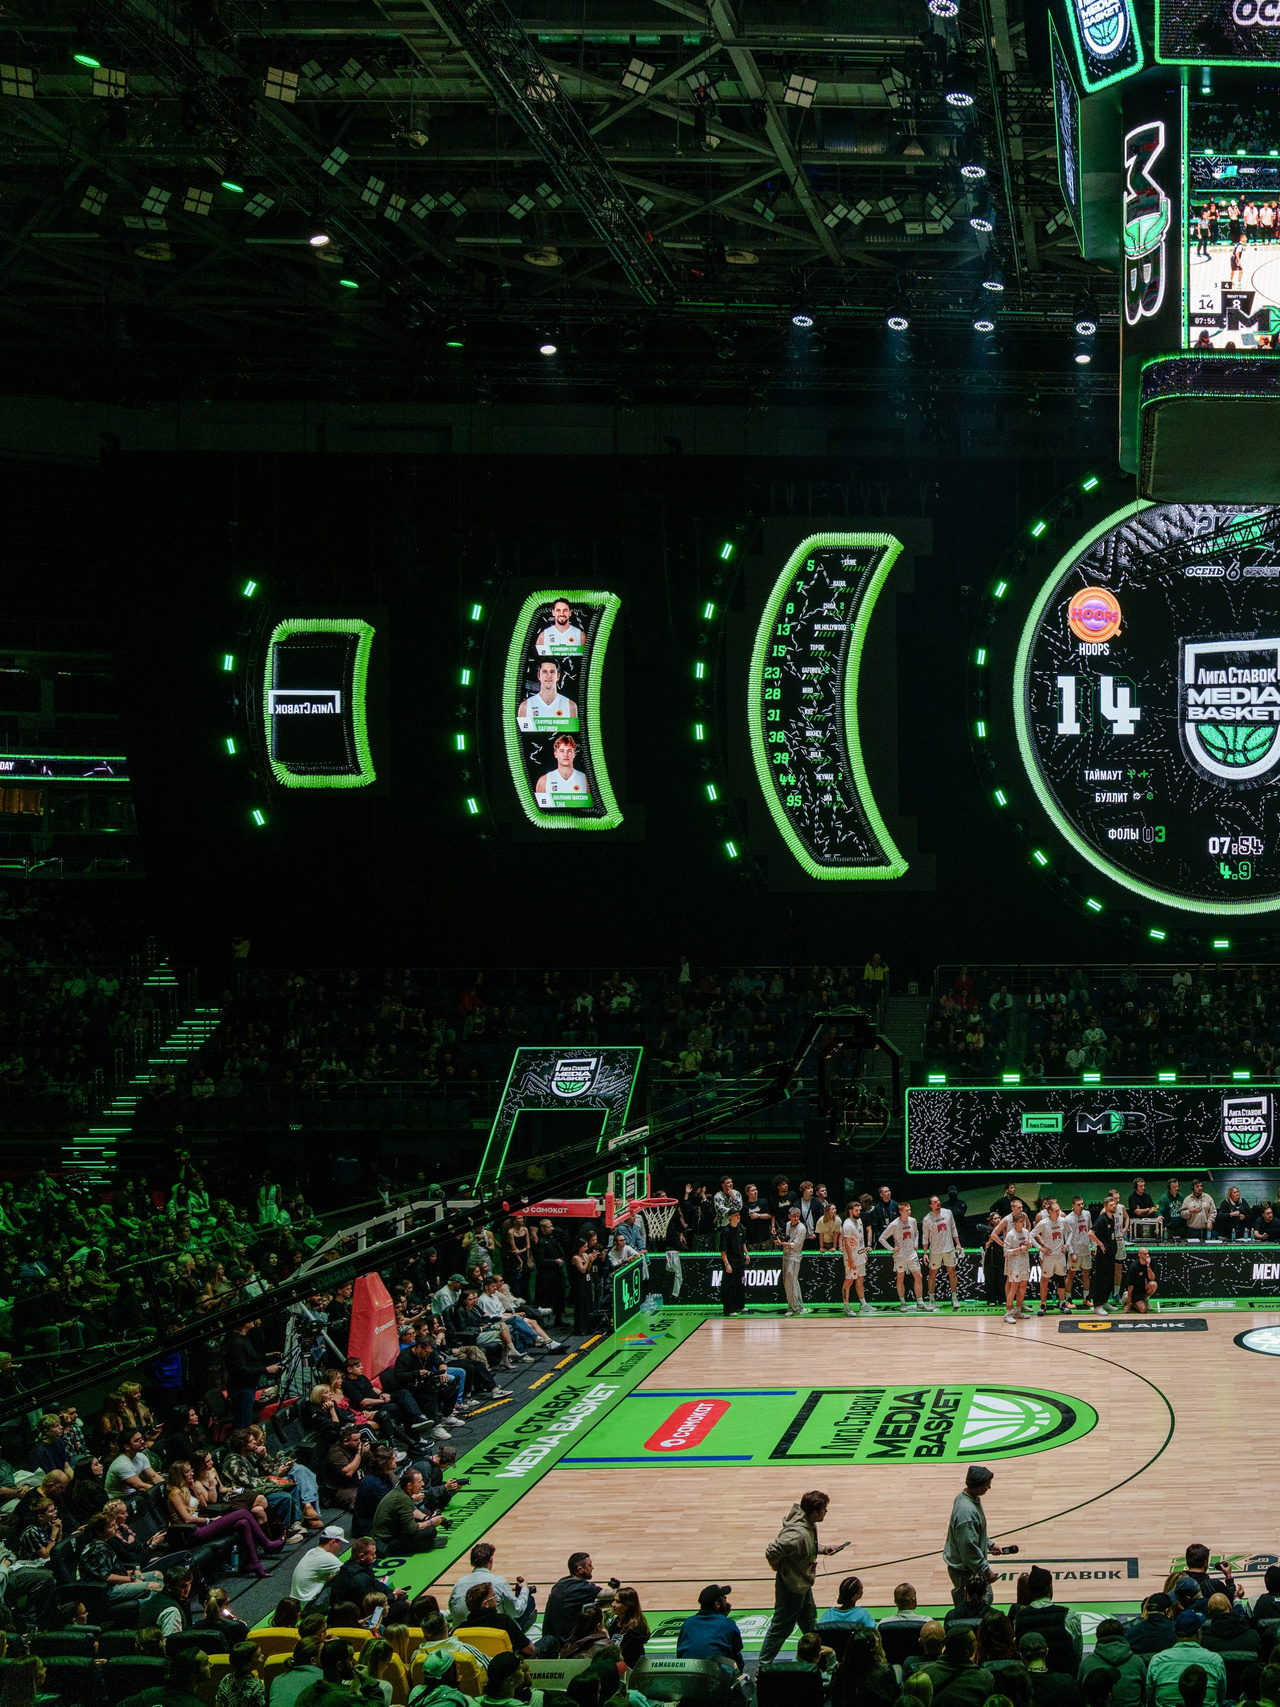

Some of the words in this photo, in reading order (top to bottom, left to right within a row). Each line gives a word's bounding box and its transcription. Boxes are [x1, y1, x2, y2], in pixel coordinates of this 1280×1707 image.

[1198, 299, 1214, 310] 14
[1232, 299, 1241, 309] 8
[1194, 317, 1216, 325] 07:56
[806, 560, 815, 571] 5
[1185, 565, 1225, 577] ОСЕНЬ
[1226, 561, 1240, 580] 6
[796, 581, 804, 593] 7
[786, 603, 794, 614] 8
[1071, 606, 1119, 623] HOOPS
[777, 624, 790, 636] 13
[772, 645, 786, 656] 15
[1079, 642, 1110, 656] HOOPS
[764, 667, 780, 679] 23
[765, 688, 781, 699] 28
[1058, 675, 1141, 735] 14
[767, 709, 780, 721] 31
[768, 731, 785, 743] 38
[773, 752, 789, 764] 39
[779, 773, 796, 786] 44
[1084, 769, 1123, 781] ТАЙМАУТ
[786, 795, 802, 807] 95
[1095, 793, 1128, 804] БУЛЛИТ
[1108, 827, 1139, 840] ФОЛЫ
[1208, 836, 1264, 855] 07:54
[1219, 862, 1251, 880] 4.9
[1253, 1263, 1280, 1280] MEN
[1118, 1322, 1185, 1330] БАНК
[866, 1389, 931, 1458] MEDIA
[913, 1389, 963, 1458] BASKET
[464, 1429, 529, 1476] ЛИГА
[514, 1384, 592, 1434] СТАВОК
[495, 1433, 562, 1478] MEDIA
[555, 1383, 620, 1432] BASKET
[1055, 1571, 1122, 1580] ТАВОК
[530, 1672, 564, 1680] YAMAGUCHI
